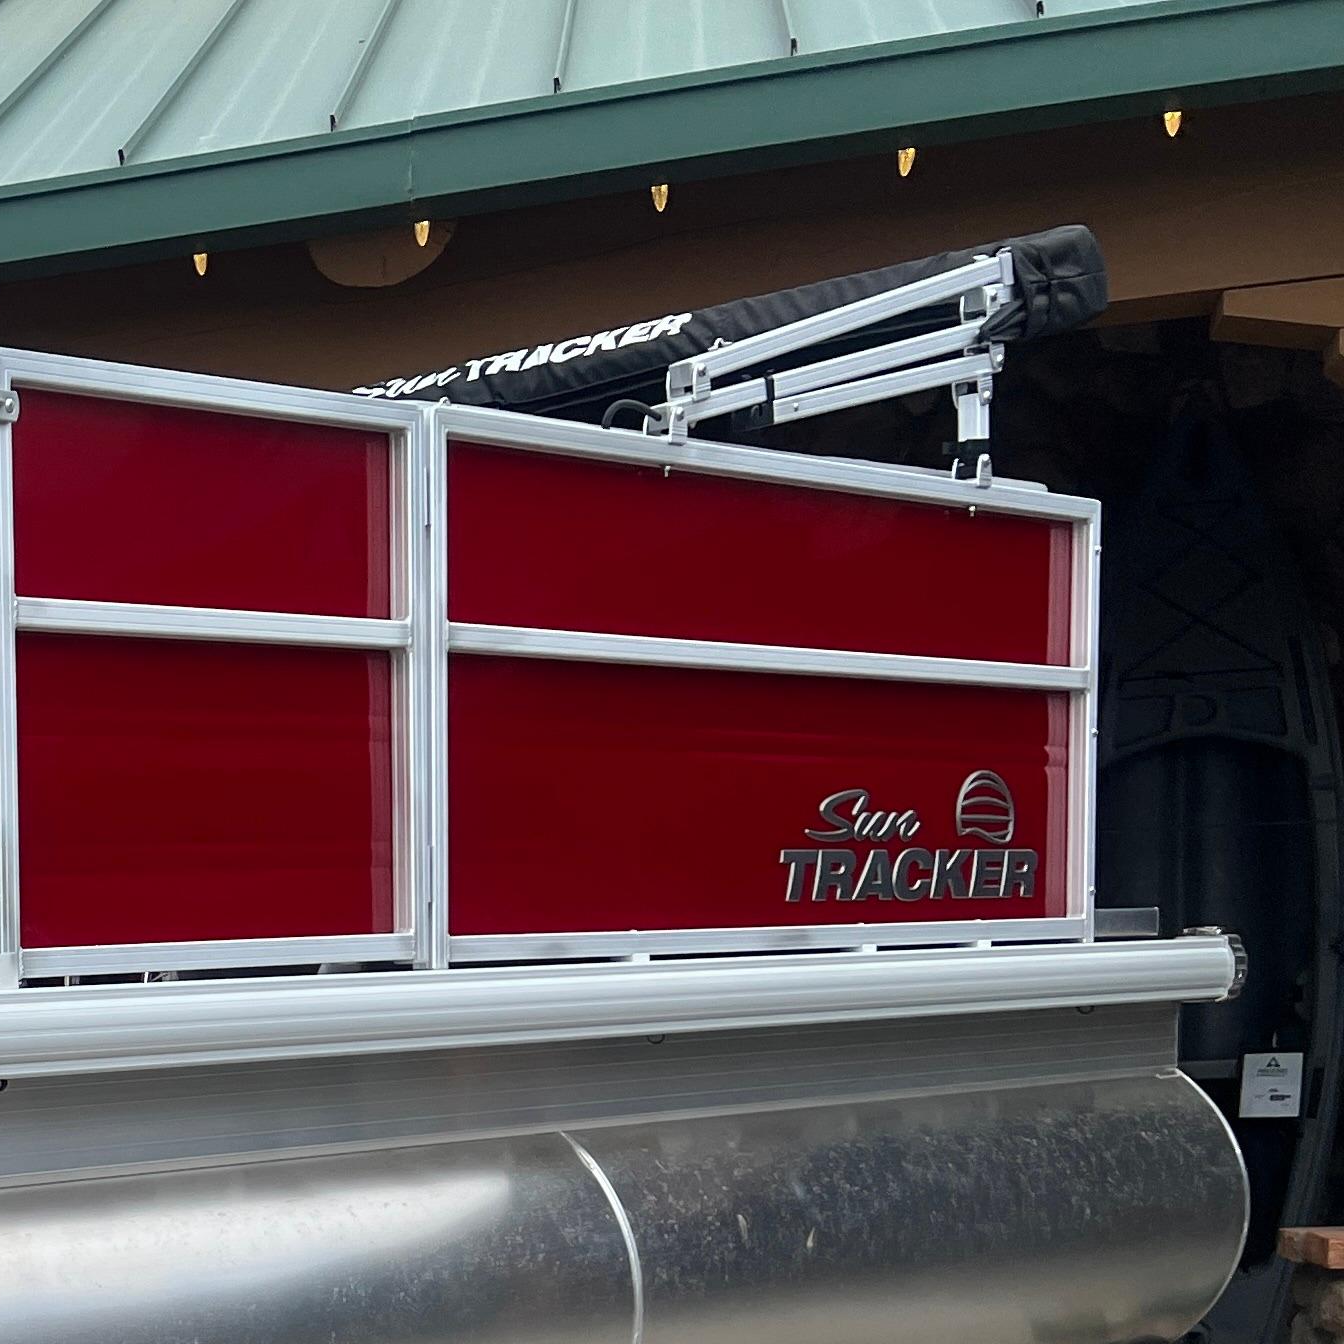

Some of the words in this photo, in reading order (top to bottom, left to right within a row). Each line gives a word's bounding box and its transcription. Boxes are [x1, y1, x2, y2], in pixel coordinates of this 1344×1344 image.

[465, 312, 693, 382] TRACKER
[804, 788, 921, 842] Sun
[779, 848, 1039, 902] TRACKER
